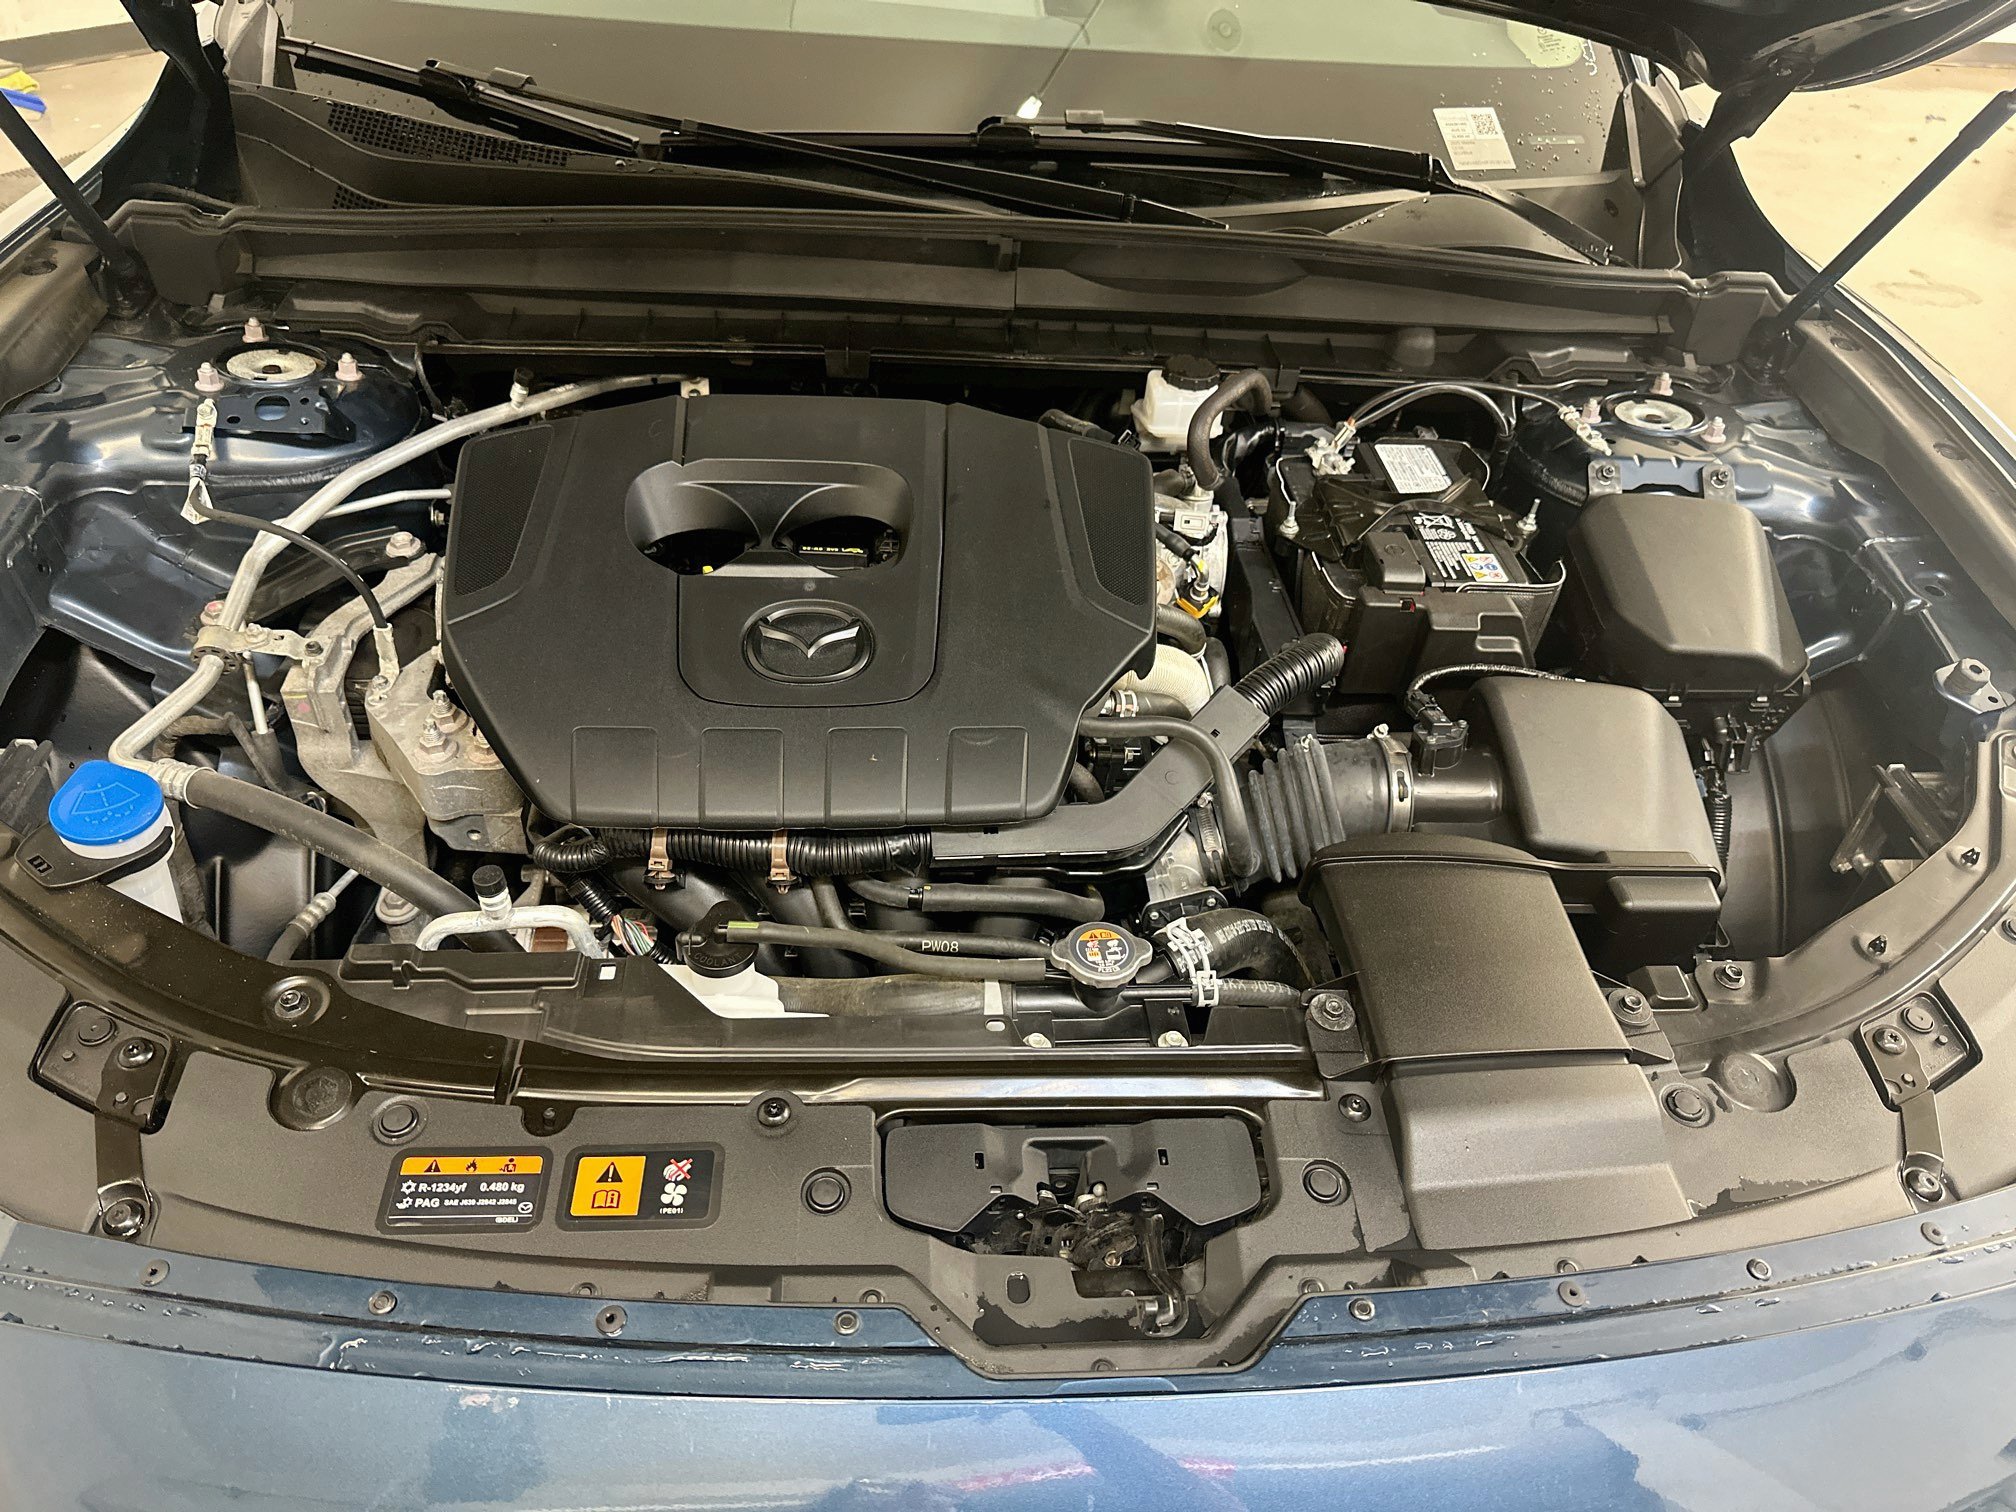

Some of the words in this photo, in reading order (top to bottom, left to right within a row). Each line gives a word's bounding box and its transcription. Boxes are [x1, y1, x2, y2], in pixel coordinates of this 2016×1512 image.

[921, 940, 959, 953] PW08
[694, 952, 743, 966] COOLANT
[418, 1182, 467, 1194] R-1234yf
[479, 1182, 509, 1192] 0.480
[510, 1181, 525, 1193] kg
[414, 1197, 440, 1208] PAG
[659, 1207, 684, 1215] (PE01)
